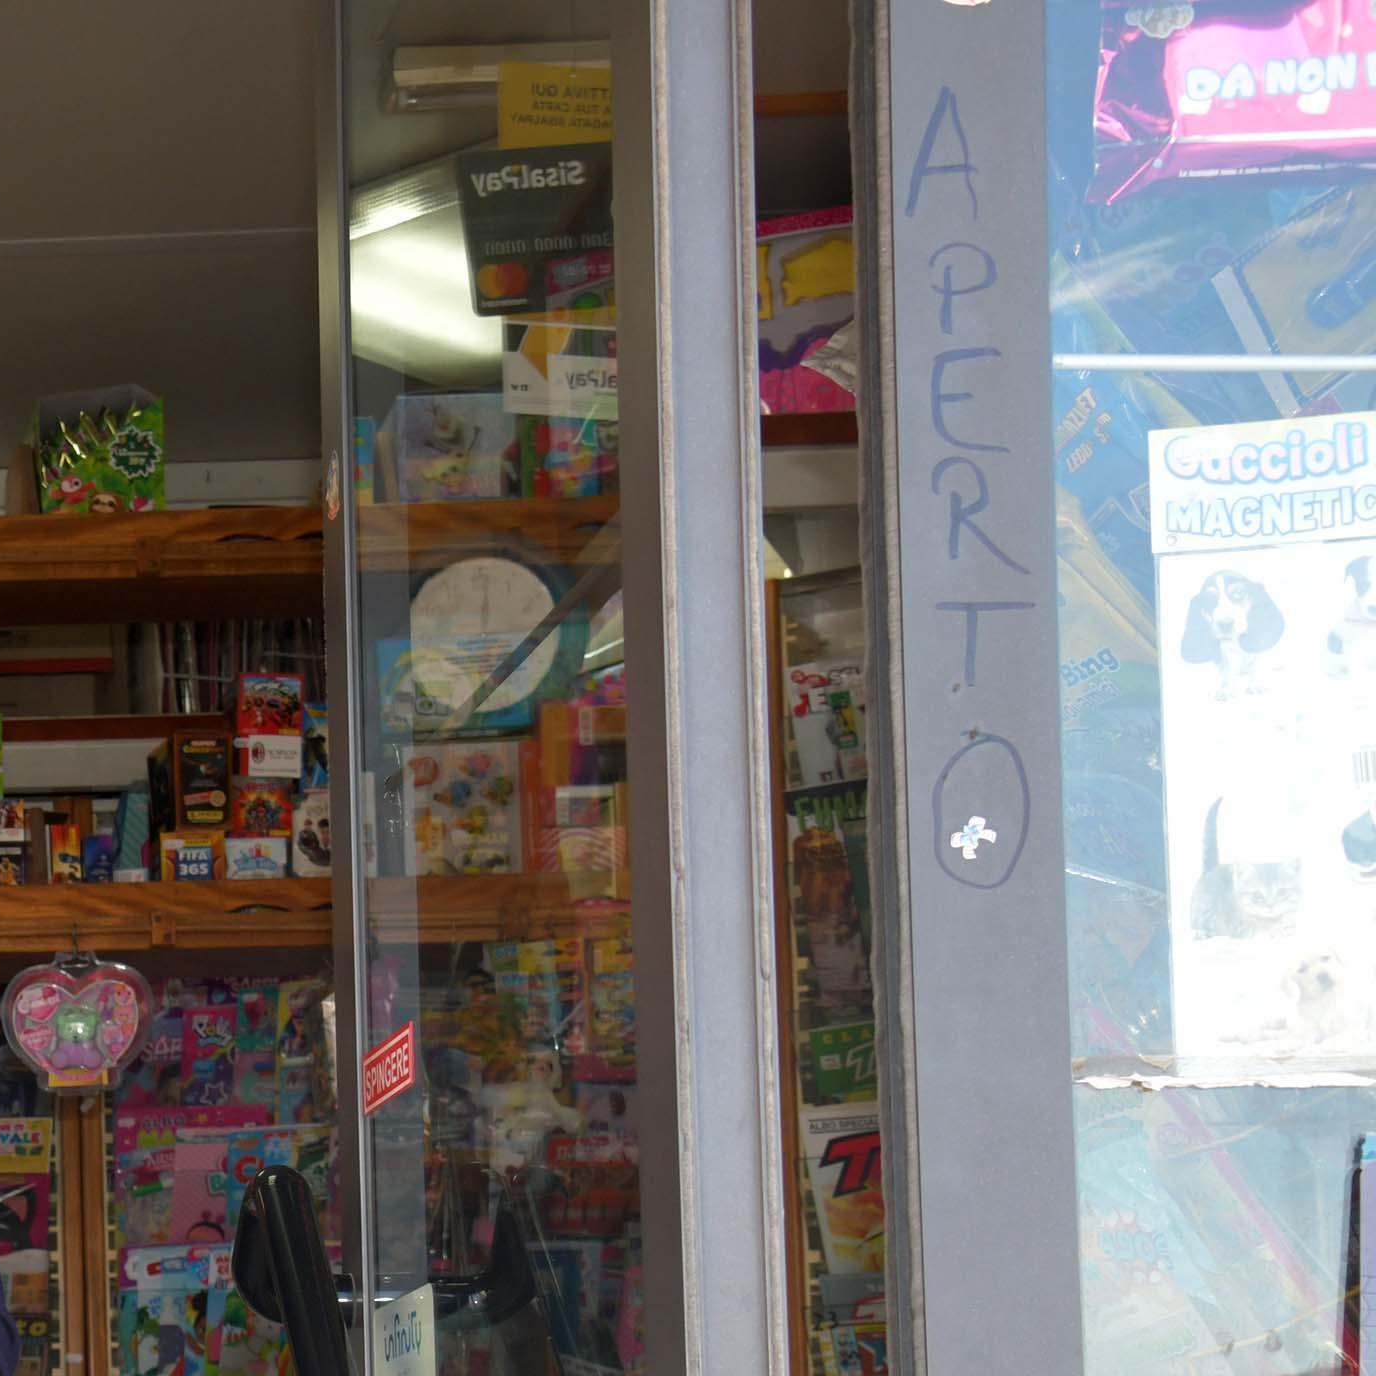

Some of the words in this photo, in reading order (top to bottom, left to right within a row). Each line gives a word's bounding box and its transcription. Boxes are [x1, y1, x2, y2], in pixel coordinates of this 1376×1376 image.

[1185, 60, 1257, 101] DA
[1263, 51, 1359, 96] NON
[178, 851, 208, 862] FIFA
[178, 863, 209, 876] 365
[365, 1042, 410, 1102] SPINGERE
